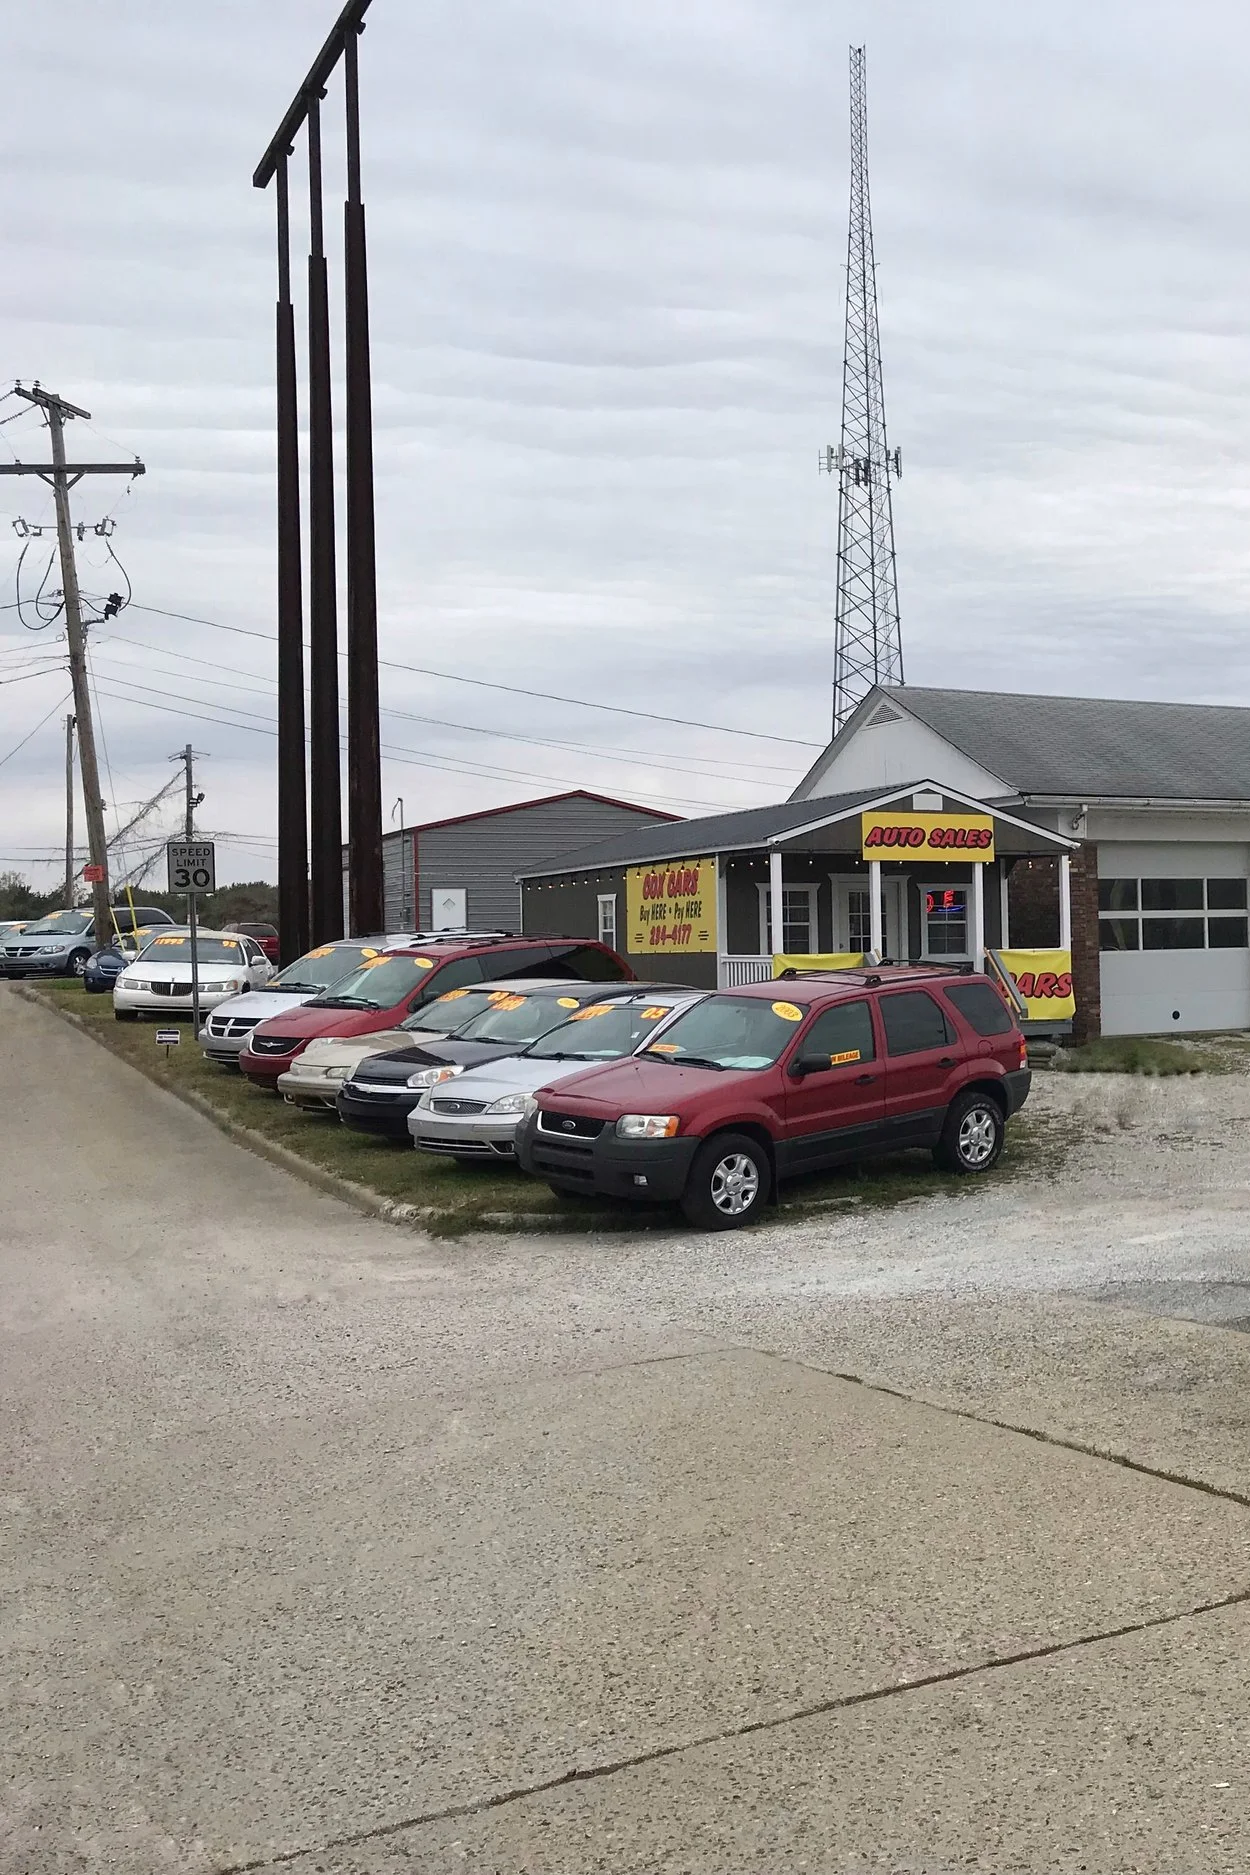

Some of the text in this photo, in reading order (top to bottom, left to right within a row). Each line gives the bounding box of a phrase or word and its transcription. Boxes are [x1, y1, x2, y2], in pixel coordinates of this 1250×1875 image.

[865, 826, 993, 849] AUTO SALES
[171, 848, 211, 857] SPEED
[177, 858, 207, 867] LIMIT
[174, 868, 211, 888] 30
[642, 868, 699, 900] COX CARS
[651, 903, 667, 921] HERE
[674, 902, 684, 924] Pay
[685, 901, 702, 919] HERE
[650, 924, 692, 945] 234-4177
[640, 1007, 670, 1019] 05
